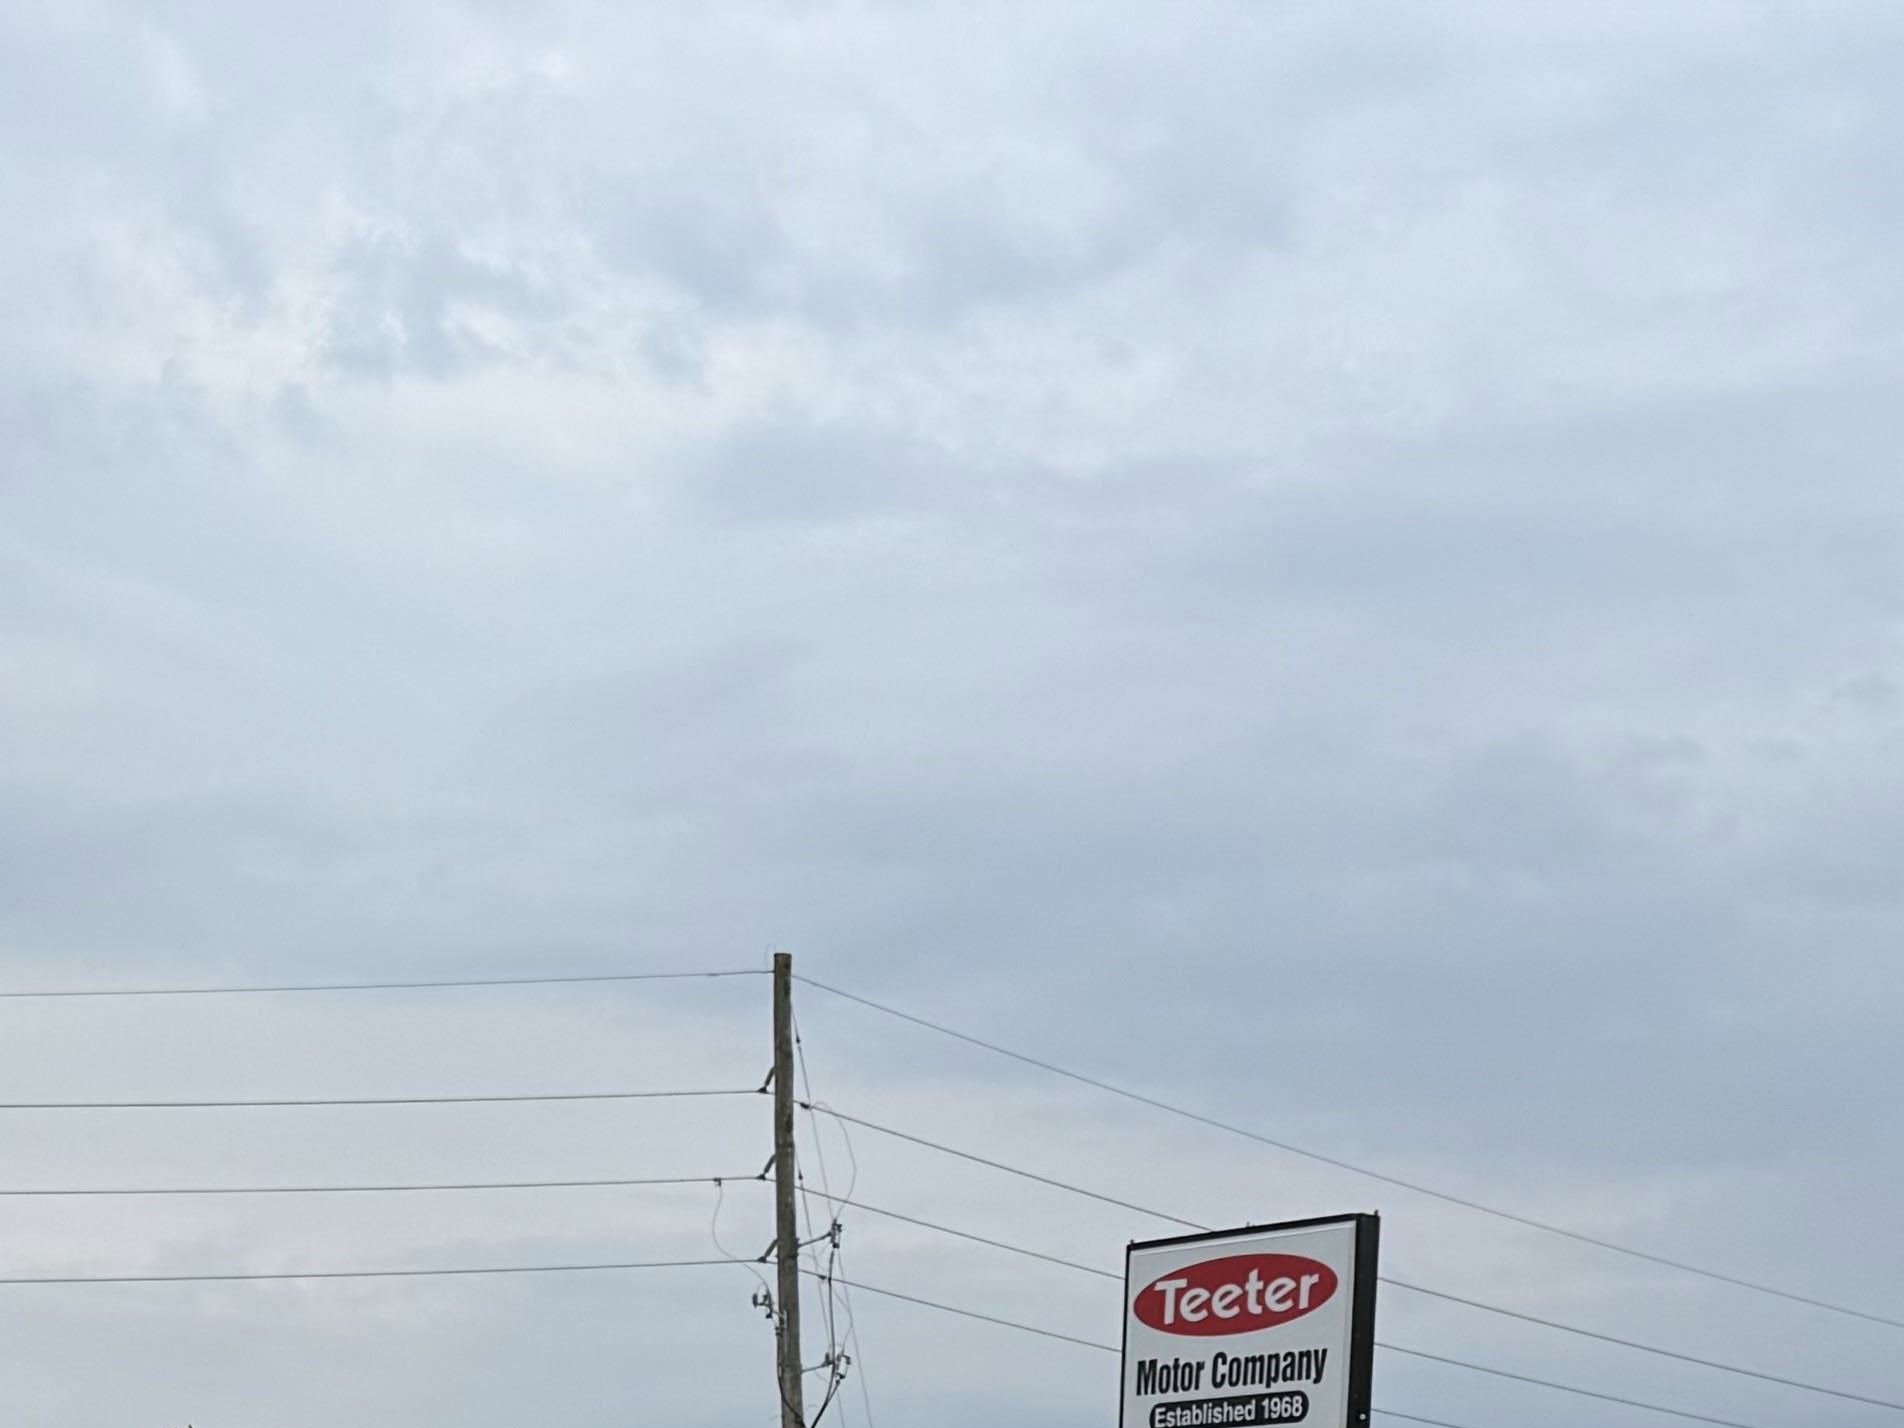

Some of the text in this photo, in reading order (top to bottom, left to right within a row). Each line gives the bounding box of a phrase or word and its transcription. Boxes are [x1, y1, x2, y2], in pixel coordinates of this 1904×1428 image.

[1153, 1268, 1320, 1325] Teeter
[1136, 1348, 1328, 1396] Motor Company
[1154, 1396, 1303, 1428] Established 1968
